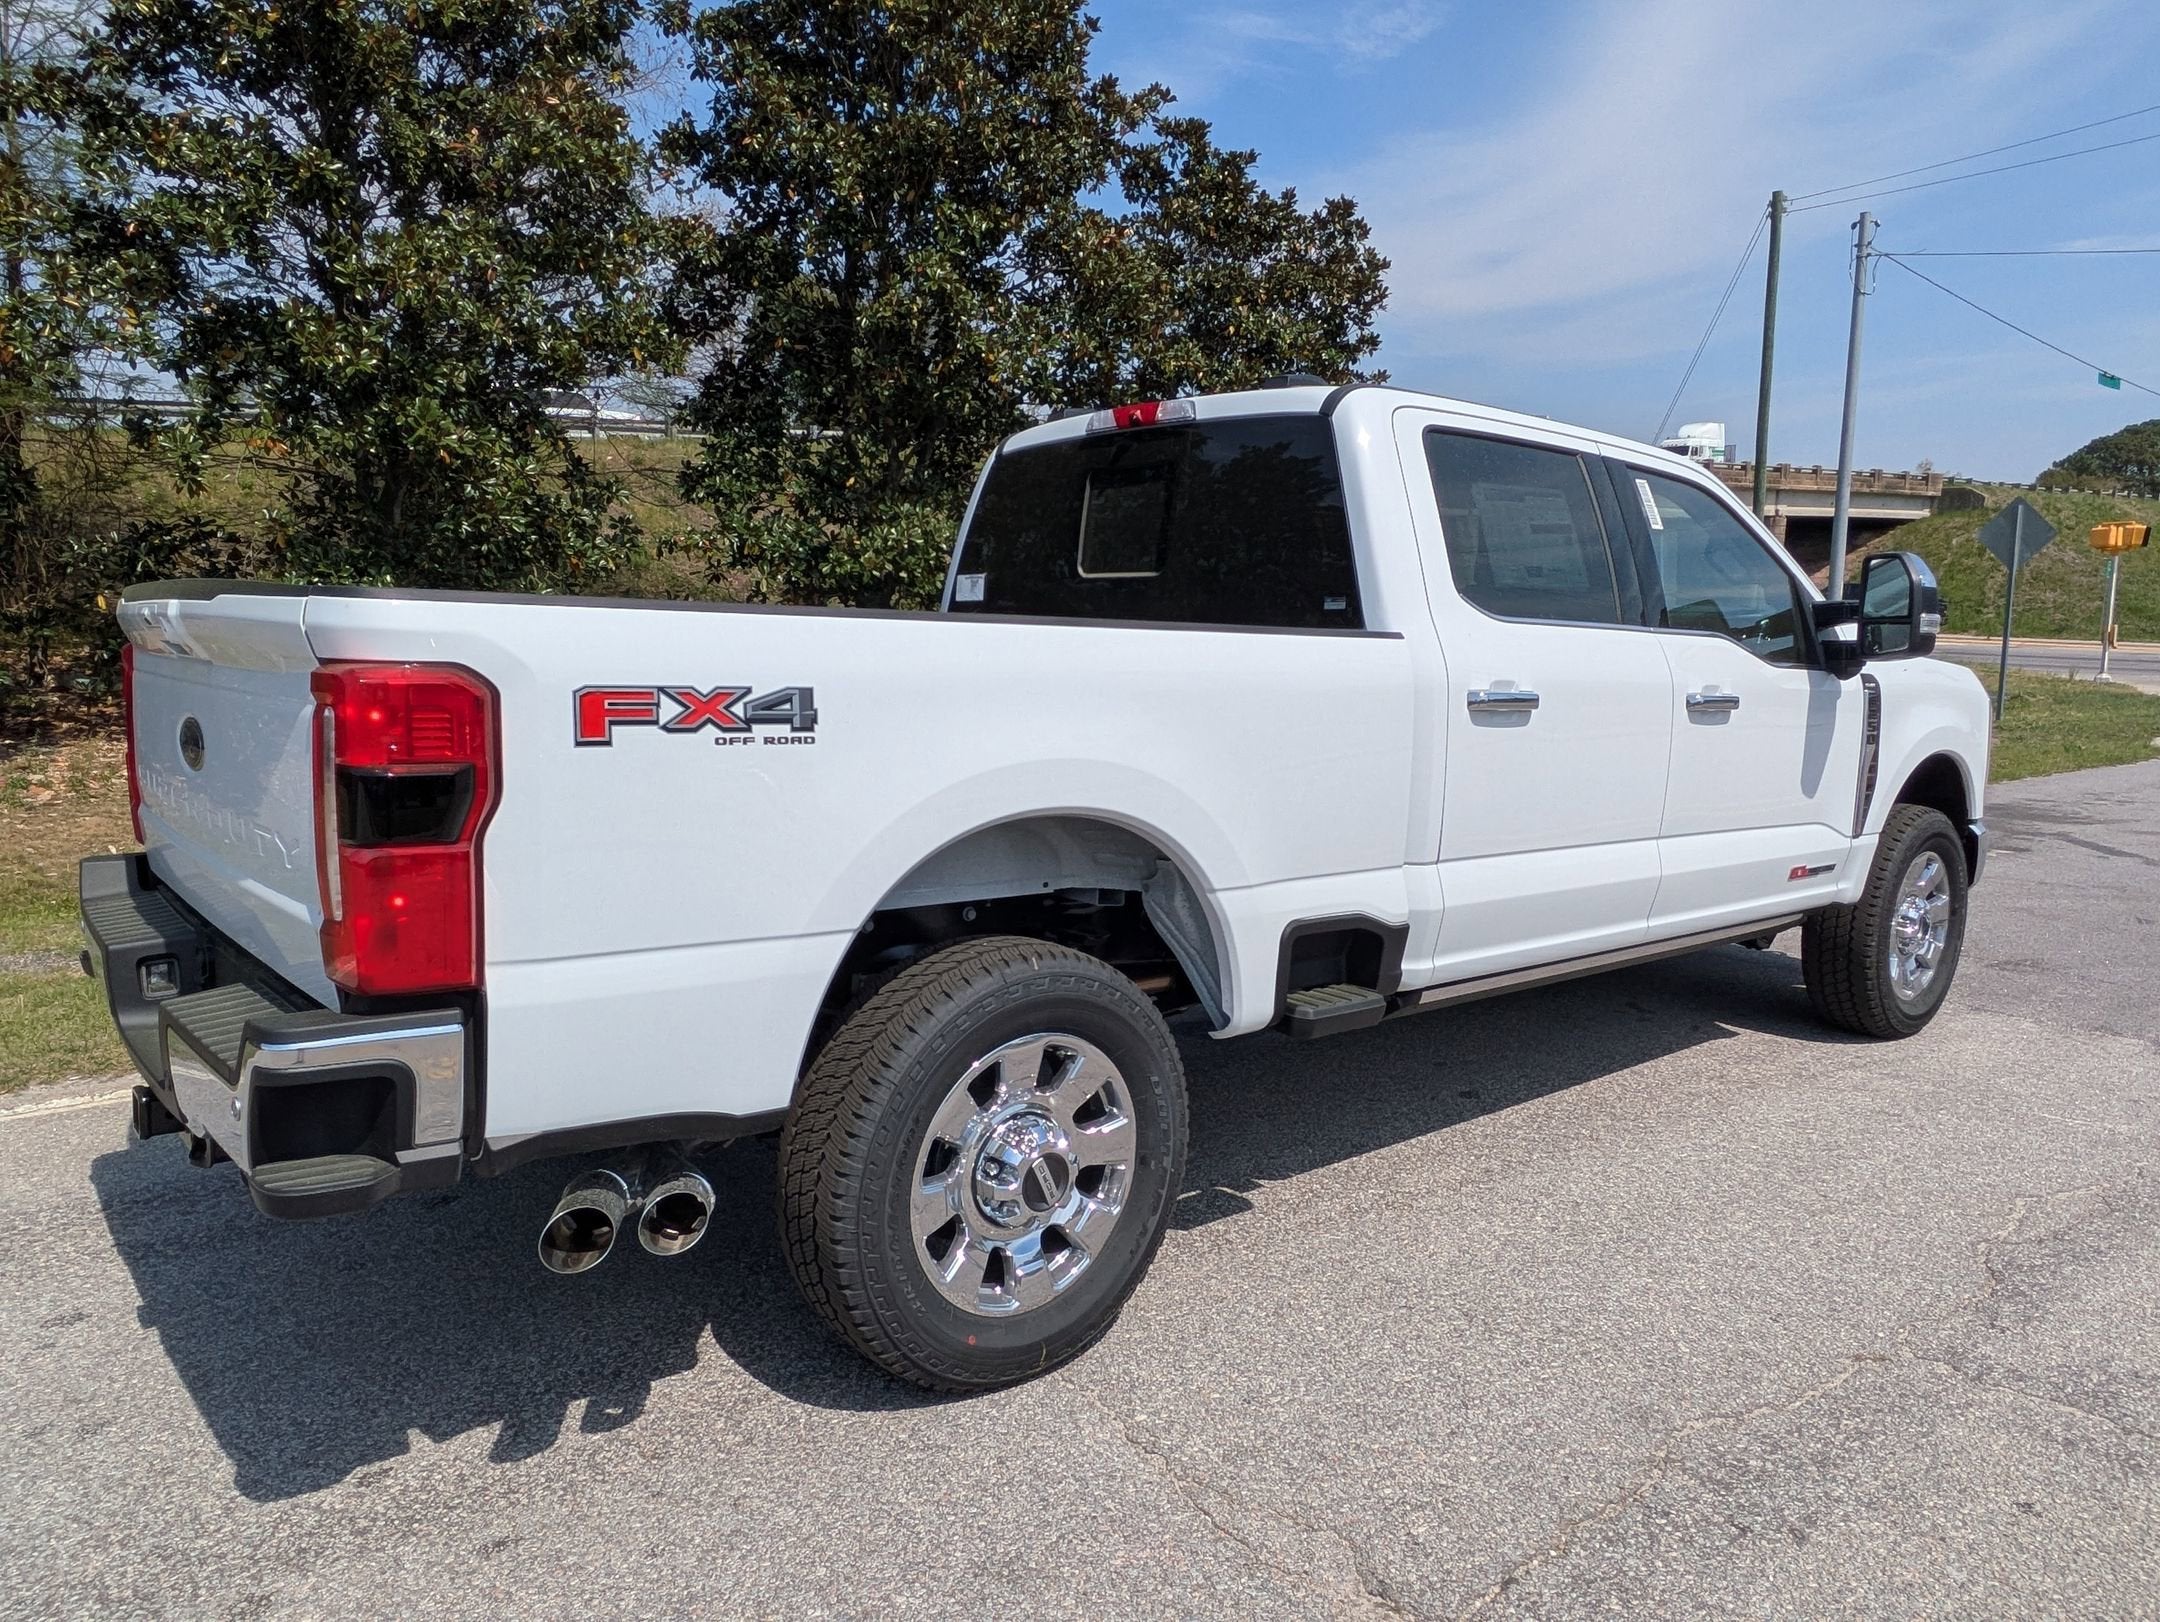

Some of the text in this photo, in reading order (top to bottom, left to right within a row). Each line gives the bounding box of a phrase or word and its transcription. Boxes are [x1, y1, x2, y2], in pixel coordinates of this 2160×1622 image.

[573, 684, 818, 748] FX4
[714, 736, 816, 746] OFF ROAD
